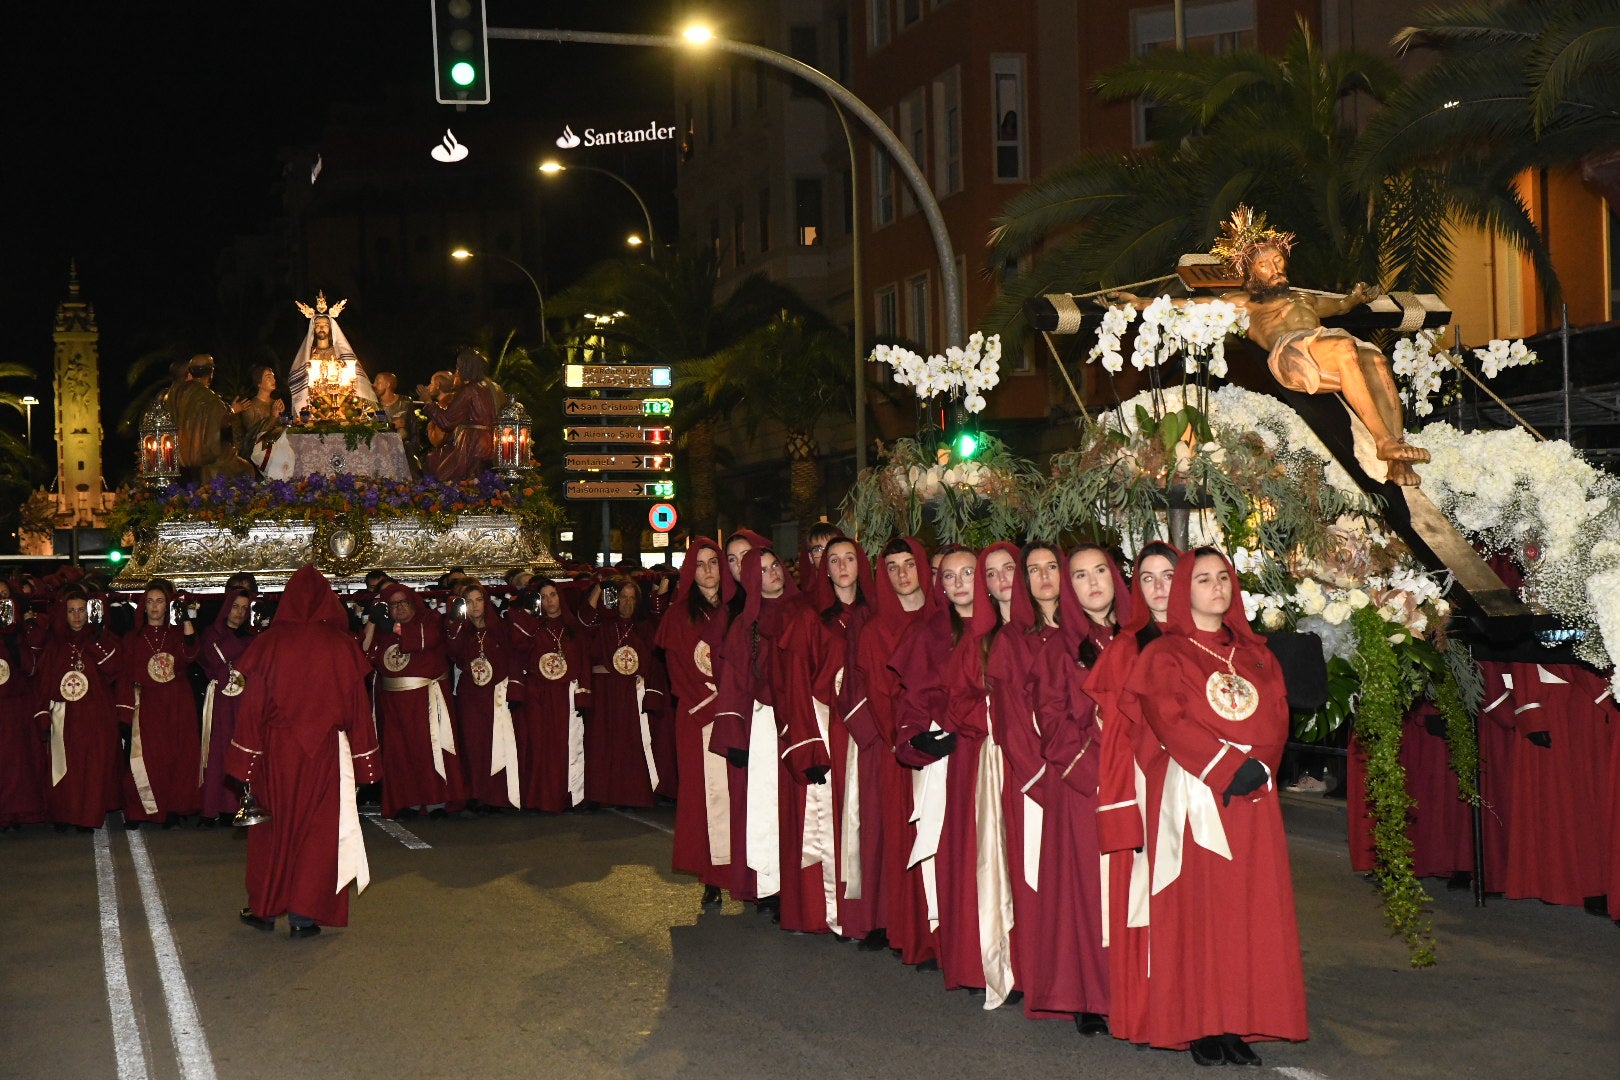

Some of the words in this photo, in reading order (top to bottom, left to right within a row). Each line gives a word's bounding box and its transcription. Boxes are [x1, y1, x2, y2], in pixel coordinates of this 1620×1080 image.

[584, 121, 676, 147] Santander
[580, 402, 598, 411] San
[567, 485, 621, 494] Maisonnave
[655, 483, 673, 496] 95
